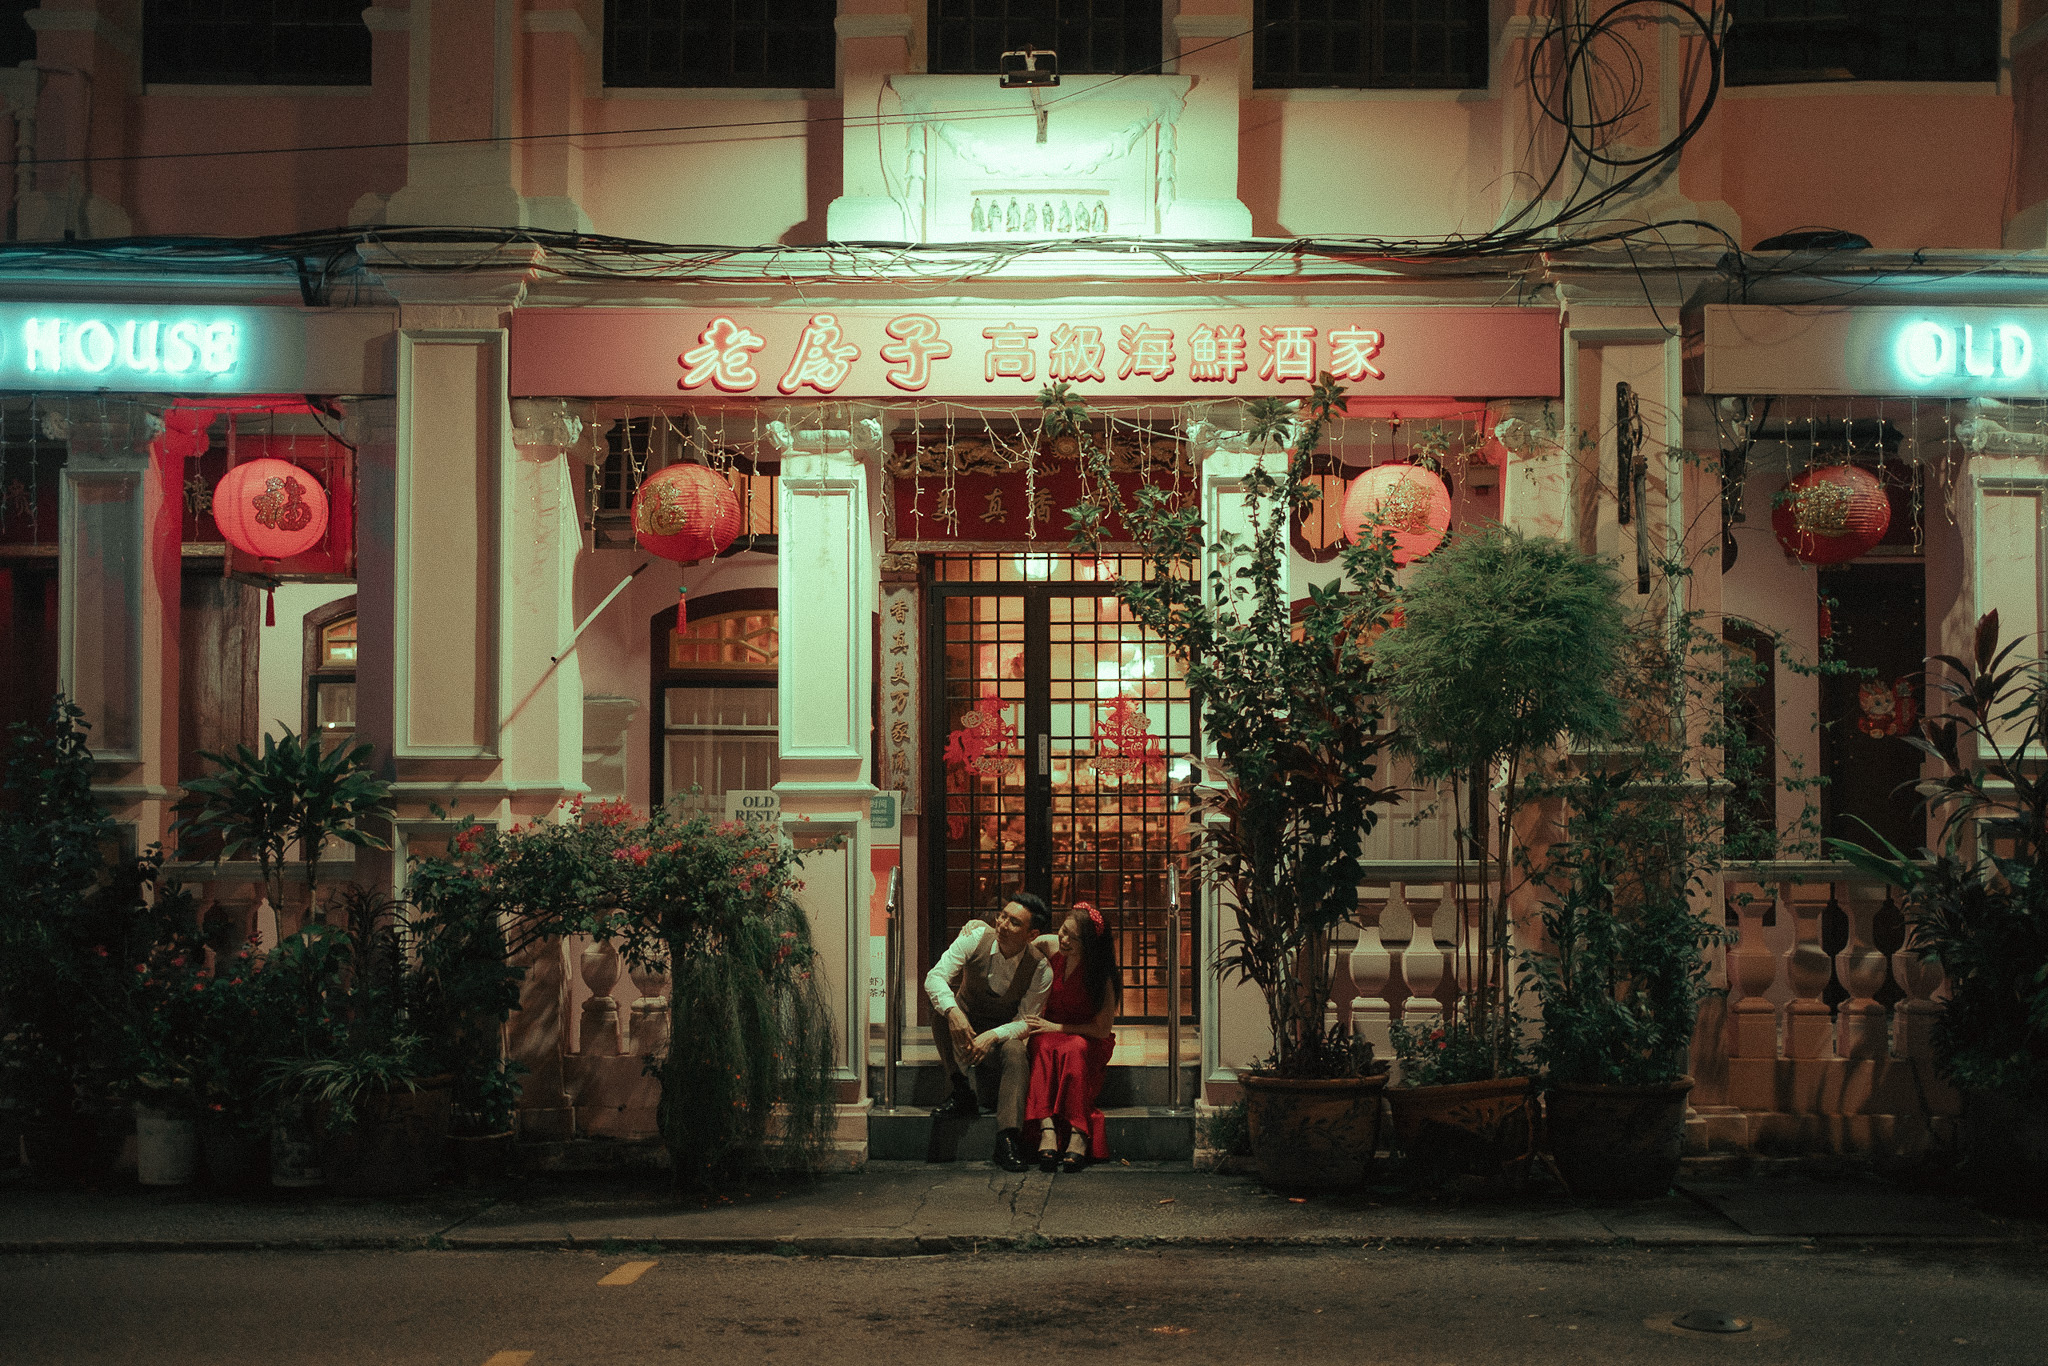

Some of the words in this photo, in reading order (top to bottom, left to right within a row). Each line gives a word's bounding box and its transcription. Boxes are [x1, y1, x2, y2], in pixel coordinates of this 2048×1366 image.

[25, 317, 239, 375] HOUSE
[677, 312, 953, 395] 老房子
[982, 322, 1386, 383] 高級海鮮酒家
[1893, 320, 2033, 378] OLD
[252, 475, 312, 531] 福
[743, 796, 774, 808] OLD
